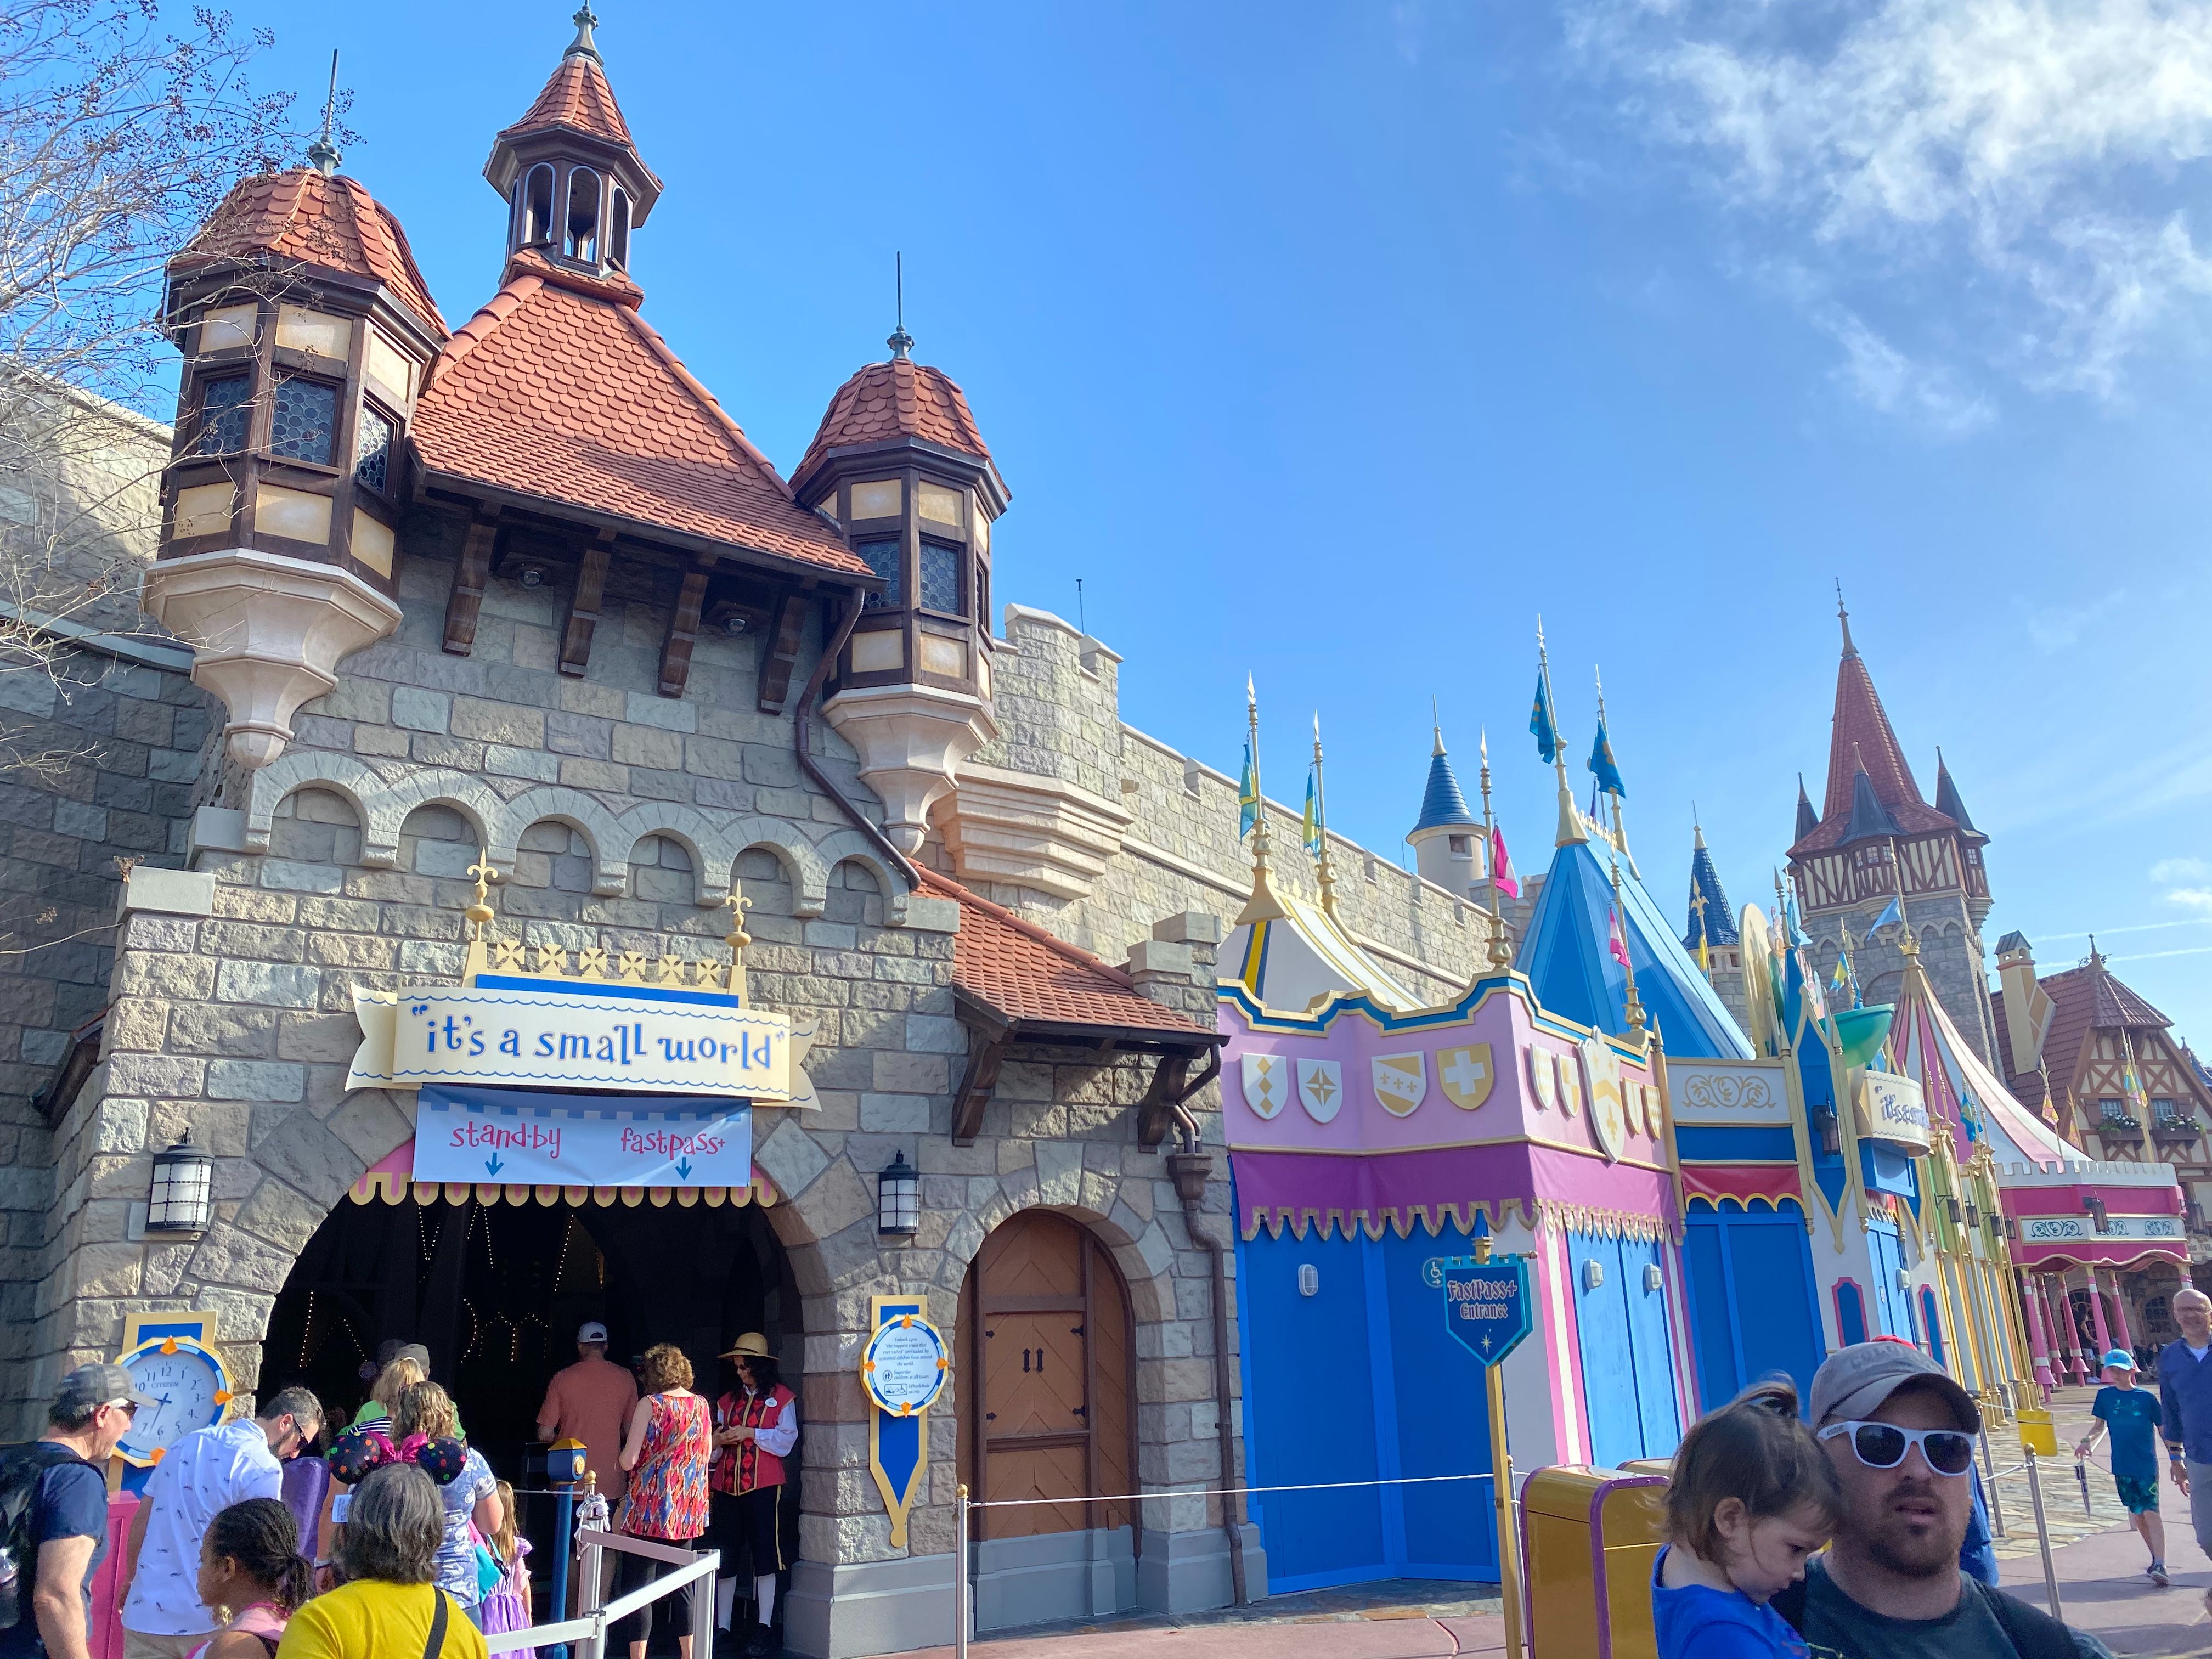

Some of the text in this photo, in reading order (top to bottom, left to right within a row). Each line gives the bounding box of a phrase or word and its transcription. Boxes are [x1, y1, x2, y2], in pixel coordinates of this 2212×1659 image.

[411, 1004, 785, 1071] "it's a small world"
[449, 1121, 561, 1159] stand-by
[620, 1127, 726, 1160] fastpass+
[1447, 1279, 1517, 1302] FastPass+
[1460, 1302, 1508, 1320] Entrance
[162, 1366, 172, 1376] 12
[182, 1370, 185, 1379] 1
[147, 1372, 156, 1381] 11
[190, 1380, 196, 1390] 2
[194, 1393, 199, 1403] 3
[188, 1409, 195, 1418] 4
[140, 1423, 148, 1434] 7
[157, 1425, 163, 1435] 6
[175, 1421, 180, 1431] 5
